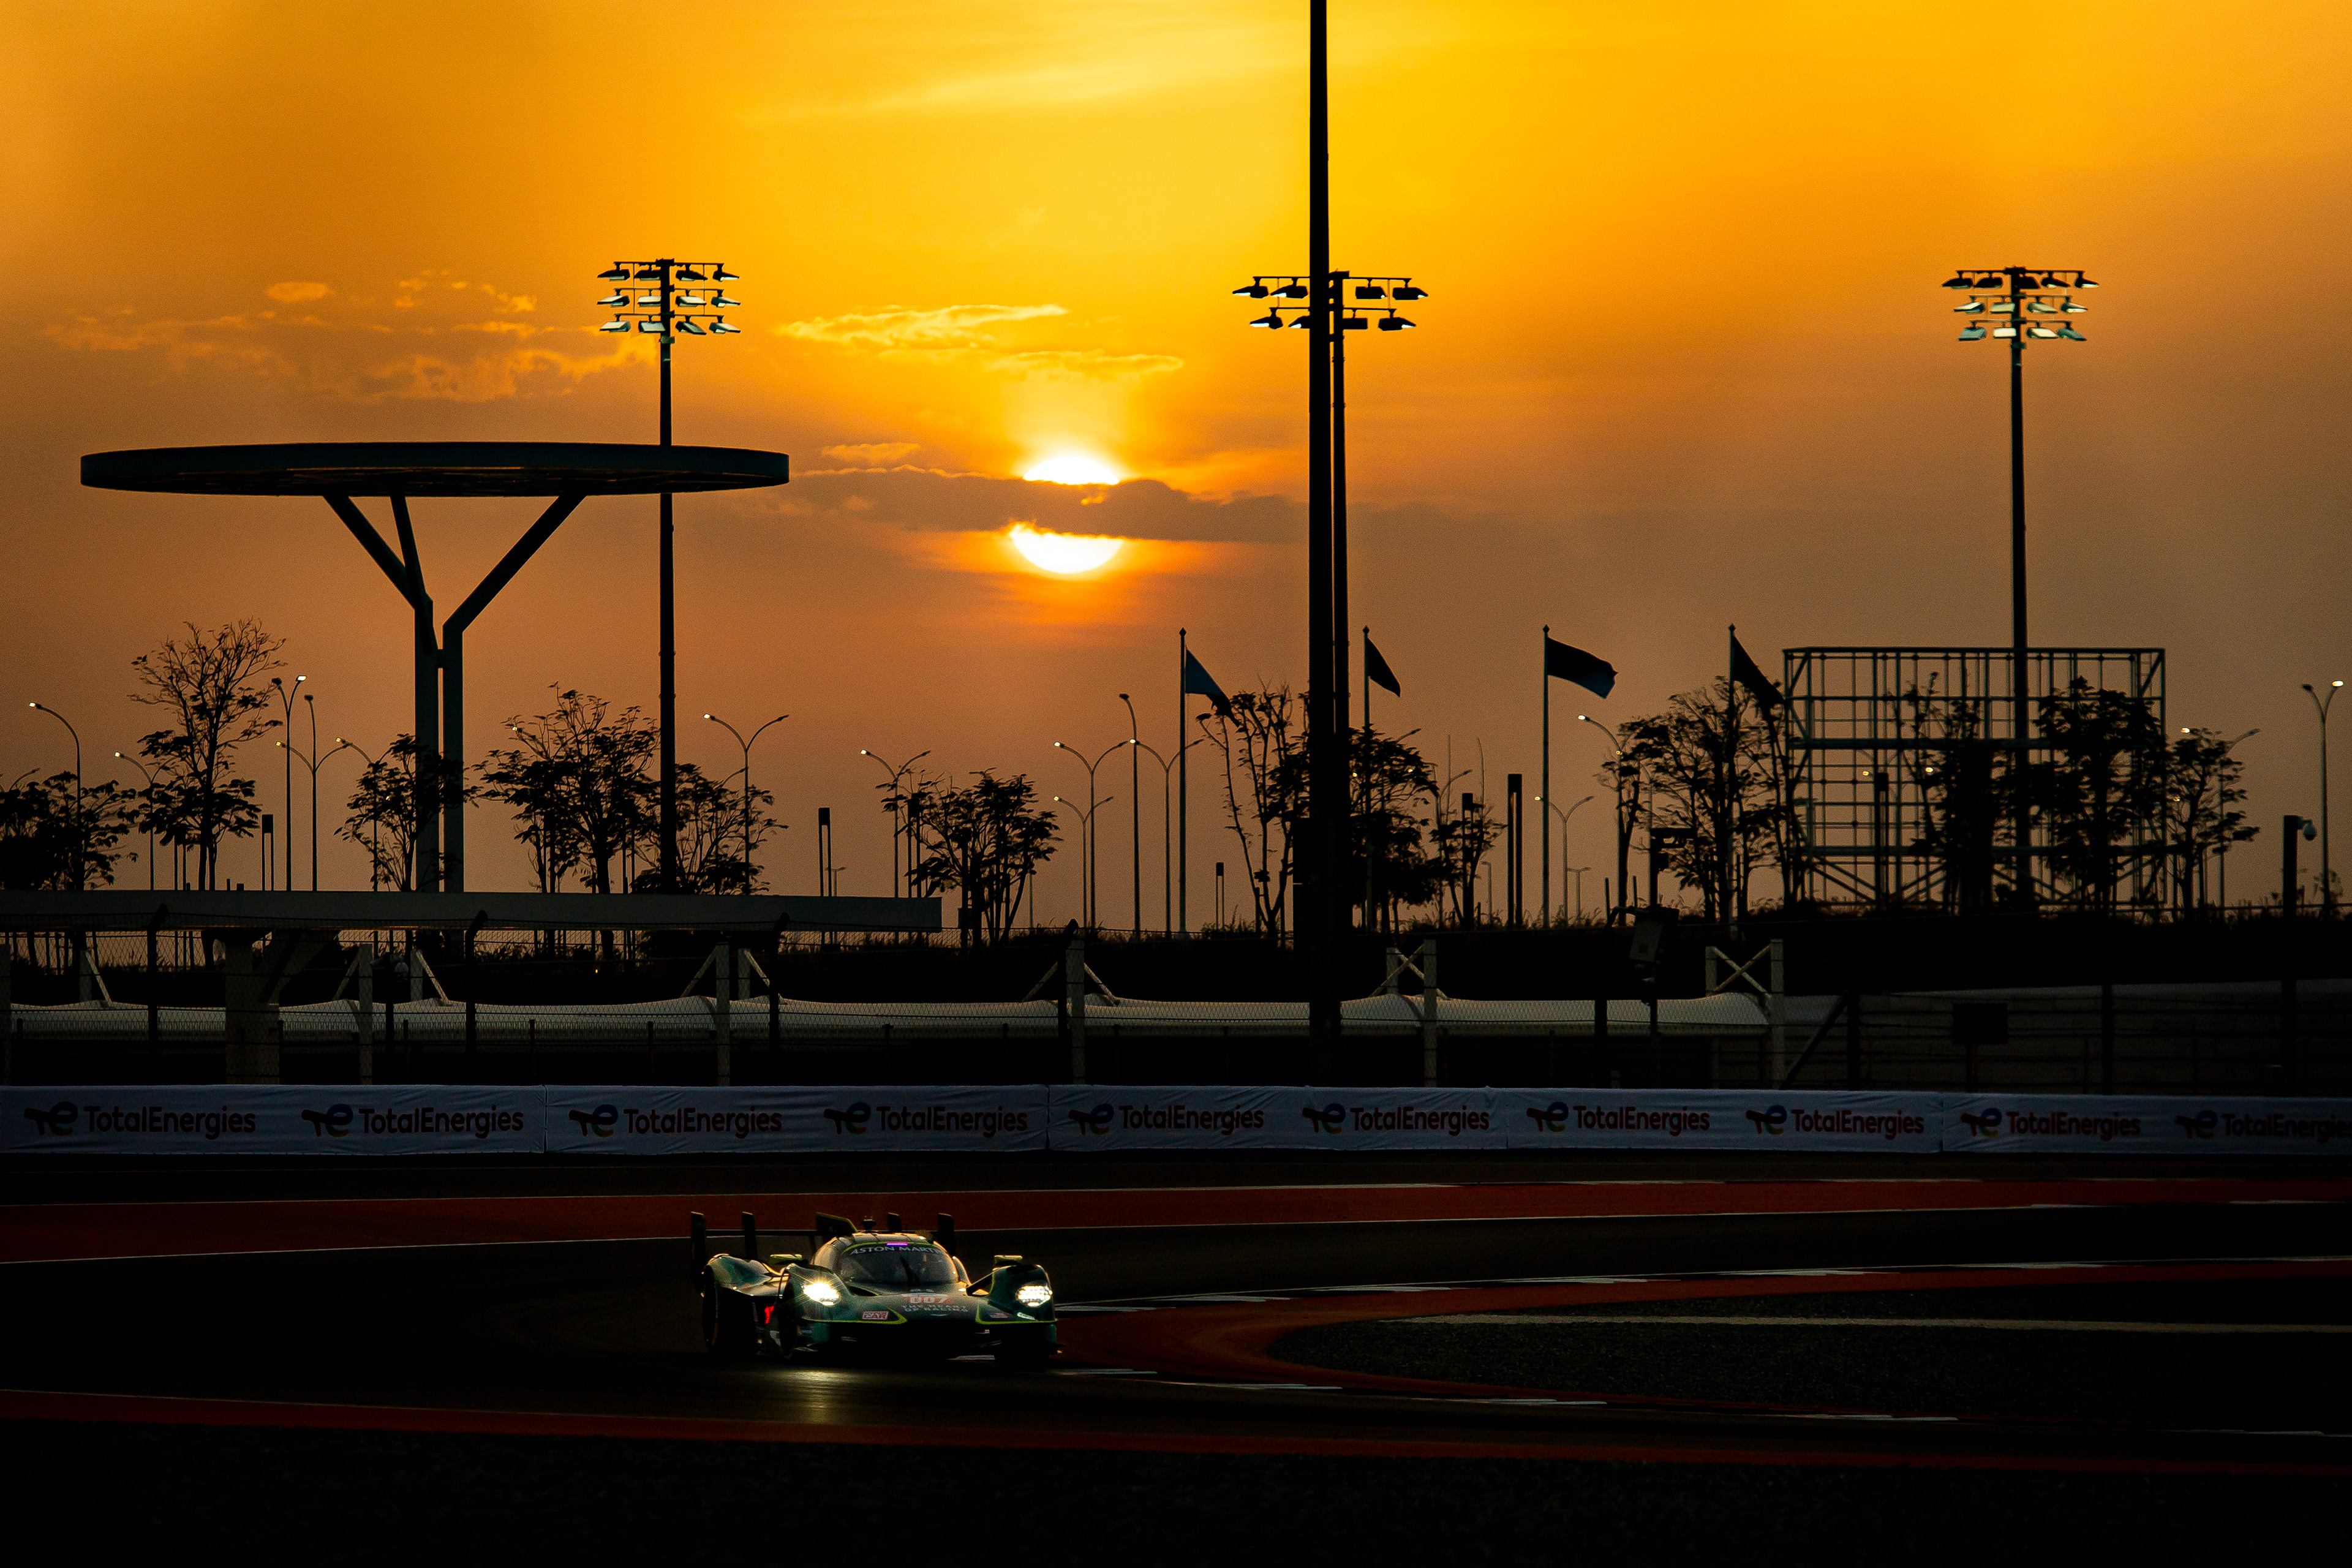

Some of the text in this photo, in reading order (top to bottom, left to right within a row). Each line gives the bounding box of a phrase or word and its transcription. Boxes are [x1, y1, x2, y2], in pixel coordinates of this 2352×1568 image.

[84, 1105, 256, 1140] TotalEnergies
[359, 1104, 524, 1139] TotalEnergies
[624, 1106, 782, 1139] TotalEnergies
[876, 1106, 1027, 1138] TotalEnergies
[1119, 1104, 1264, 1135] TotalEnergies
[1351, 1105, 1489, 1136] TotalEnergies
[1573, 1106, 1710, 1136] TotalEnergies
[1791, 1109, 1924, 1140] TotalEnergies
[2007, 1112, 2141, 1141] TotalEnergies
[850, 1246, 894, 1256] ASTON
